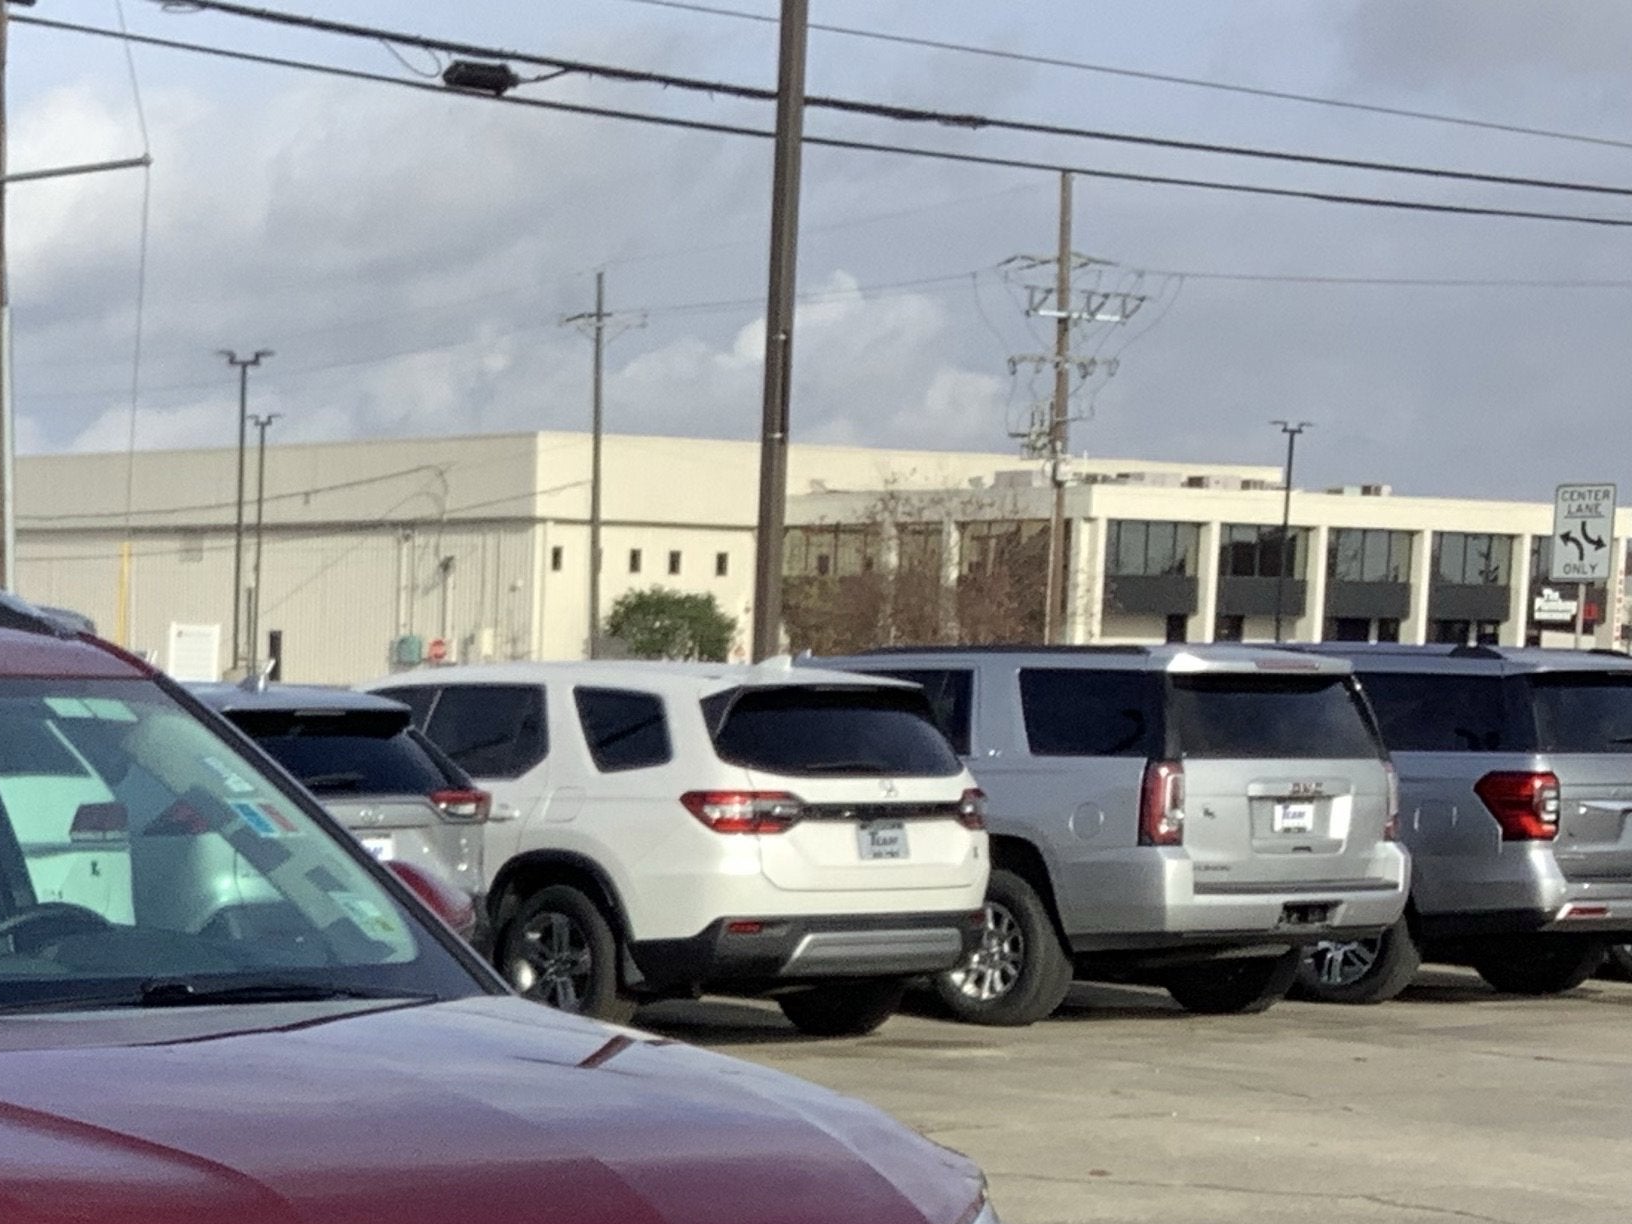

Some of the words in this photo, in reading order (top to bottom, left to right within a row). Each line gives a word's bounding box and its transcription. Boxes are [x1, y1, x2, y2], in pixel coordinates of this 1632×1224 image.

[1561, 488, 1611, 502] CENTER
[1567, 502, 1603, 516] LANE
[1562, 562, 1599, 576] ONLY
